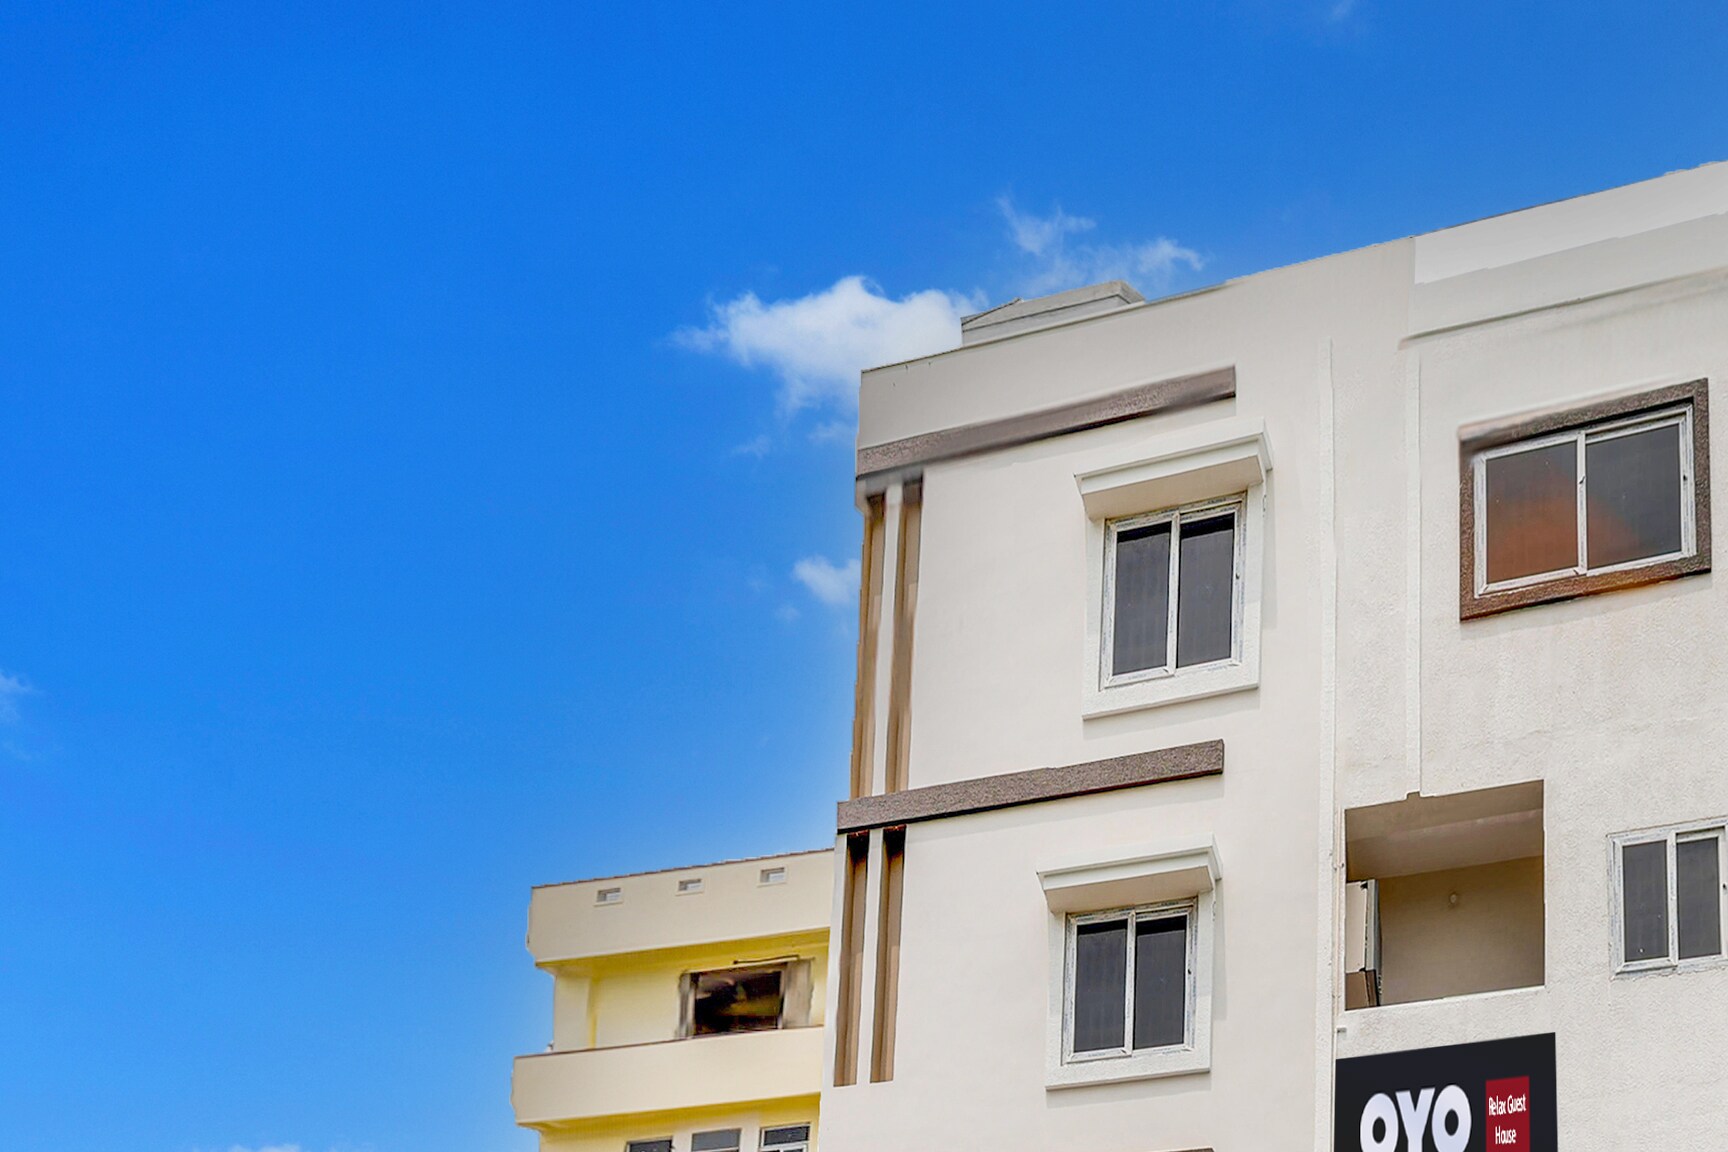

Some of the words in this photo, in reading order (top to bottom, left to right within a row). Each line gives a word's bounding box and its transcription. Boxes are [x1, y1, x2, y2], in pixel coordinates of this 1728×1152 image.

[1488, 1095, 1506, 1116] Relax
[1507, 1093, 1527, 1114] Guest
[1495, 1125, 1516, 1145] House
